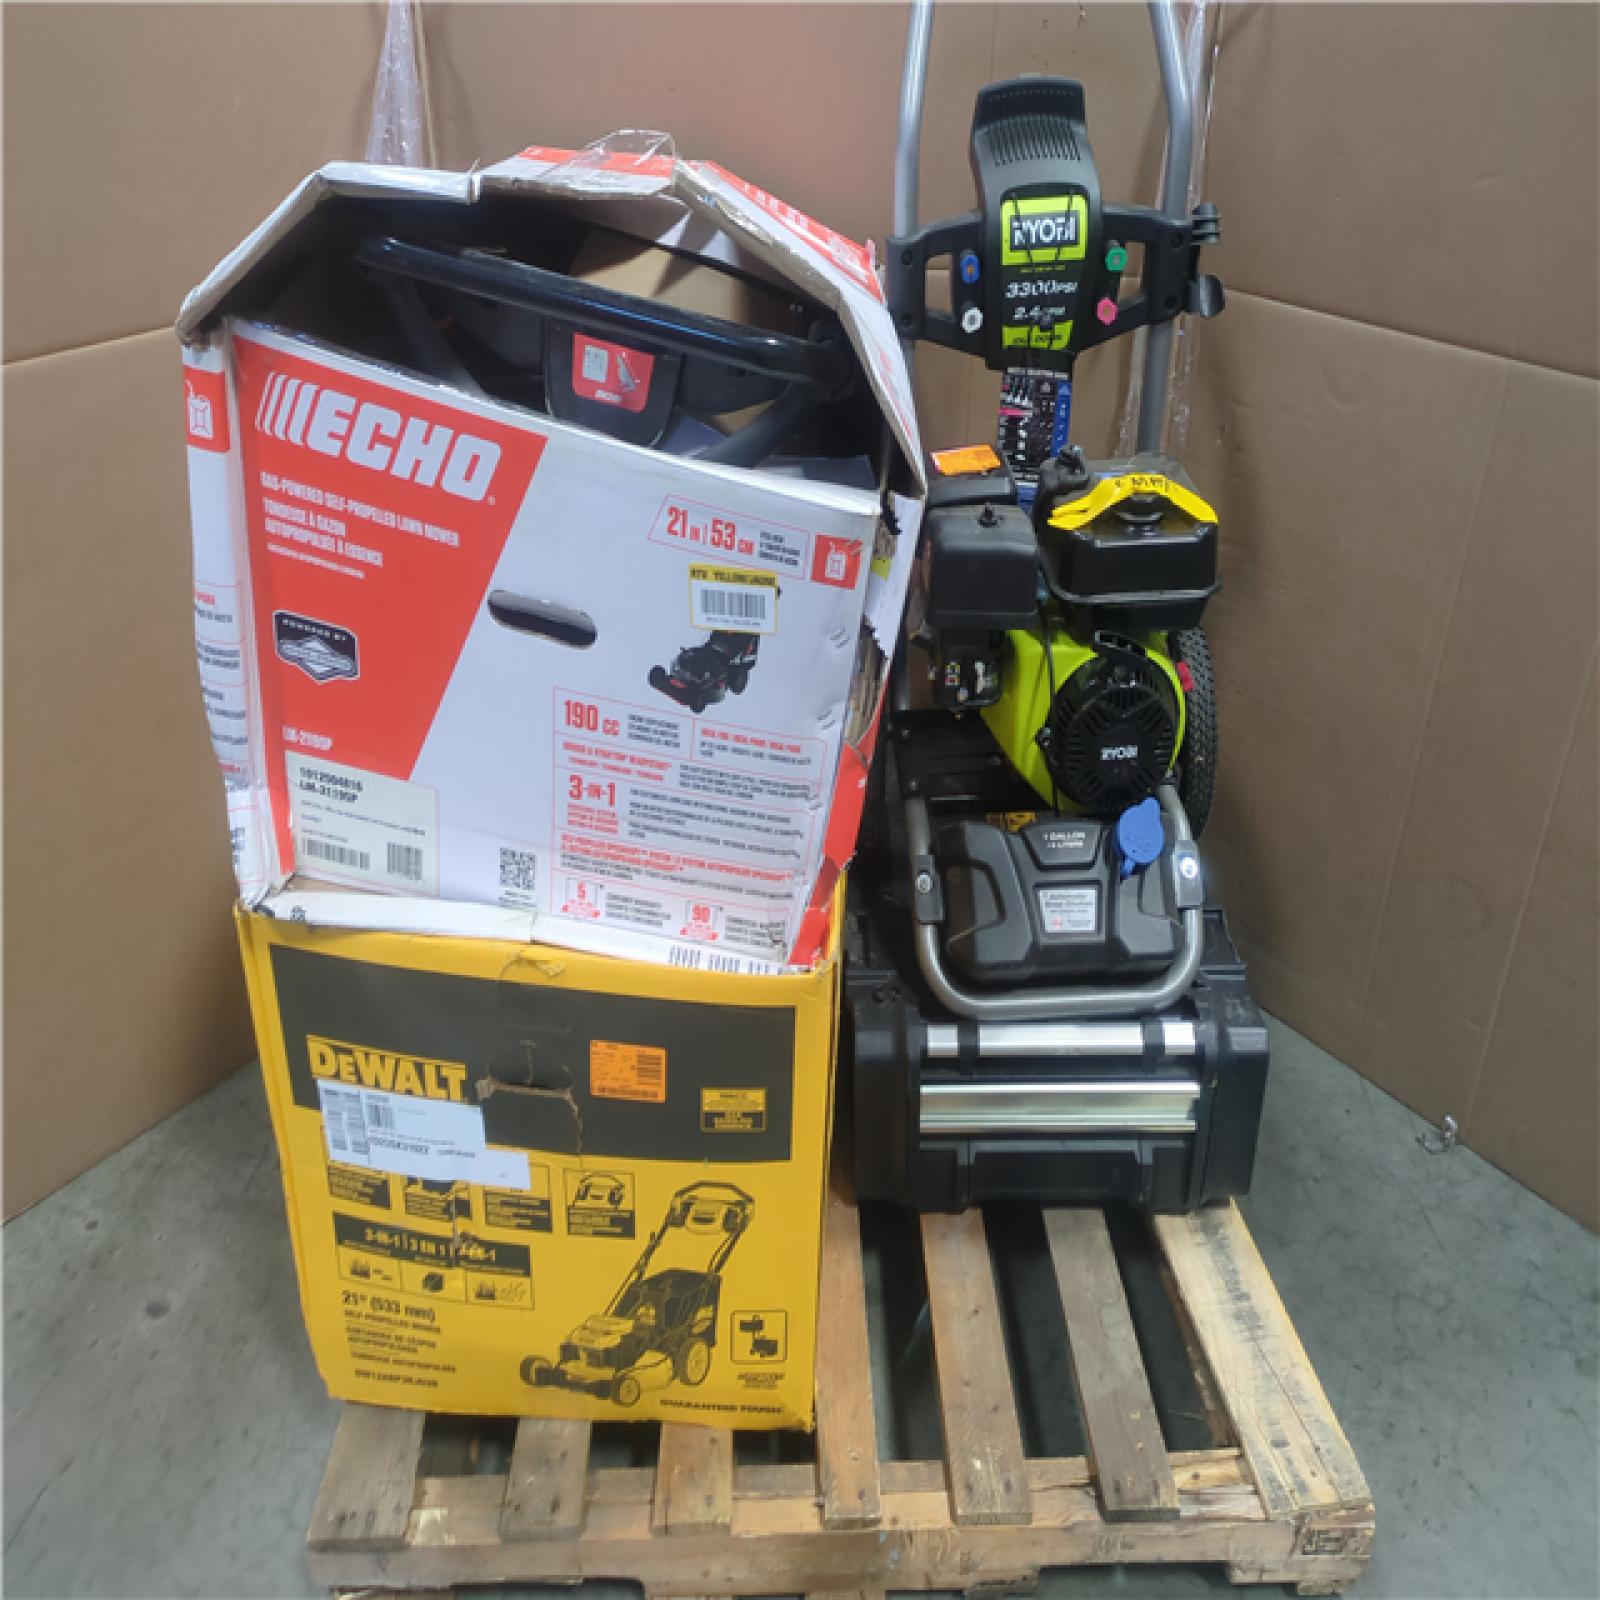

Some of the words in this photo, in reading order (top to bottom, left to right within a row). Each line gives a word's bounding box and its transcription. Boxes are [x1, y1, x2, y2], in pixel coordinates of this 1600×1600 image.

[307, 388, 502, 501] ECHO
[666, 506, 688, 538] 21
[710, 517, 736, 550] 53
[564, 699, 599, 731] 190
